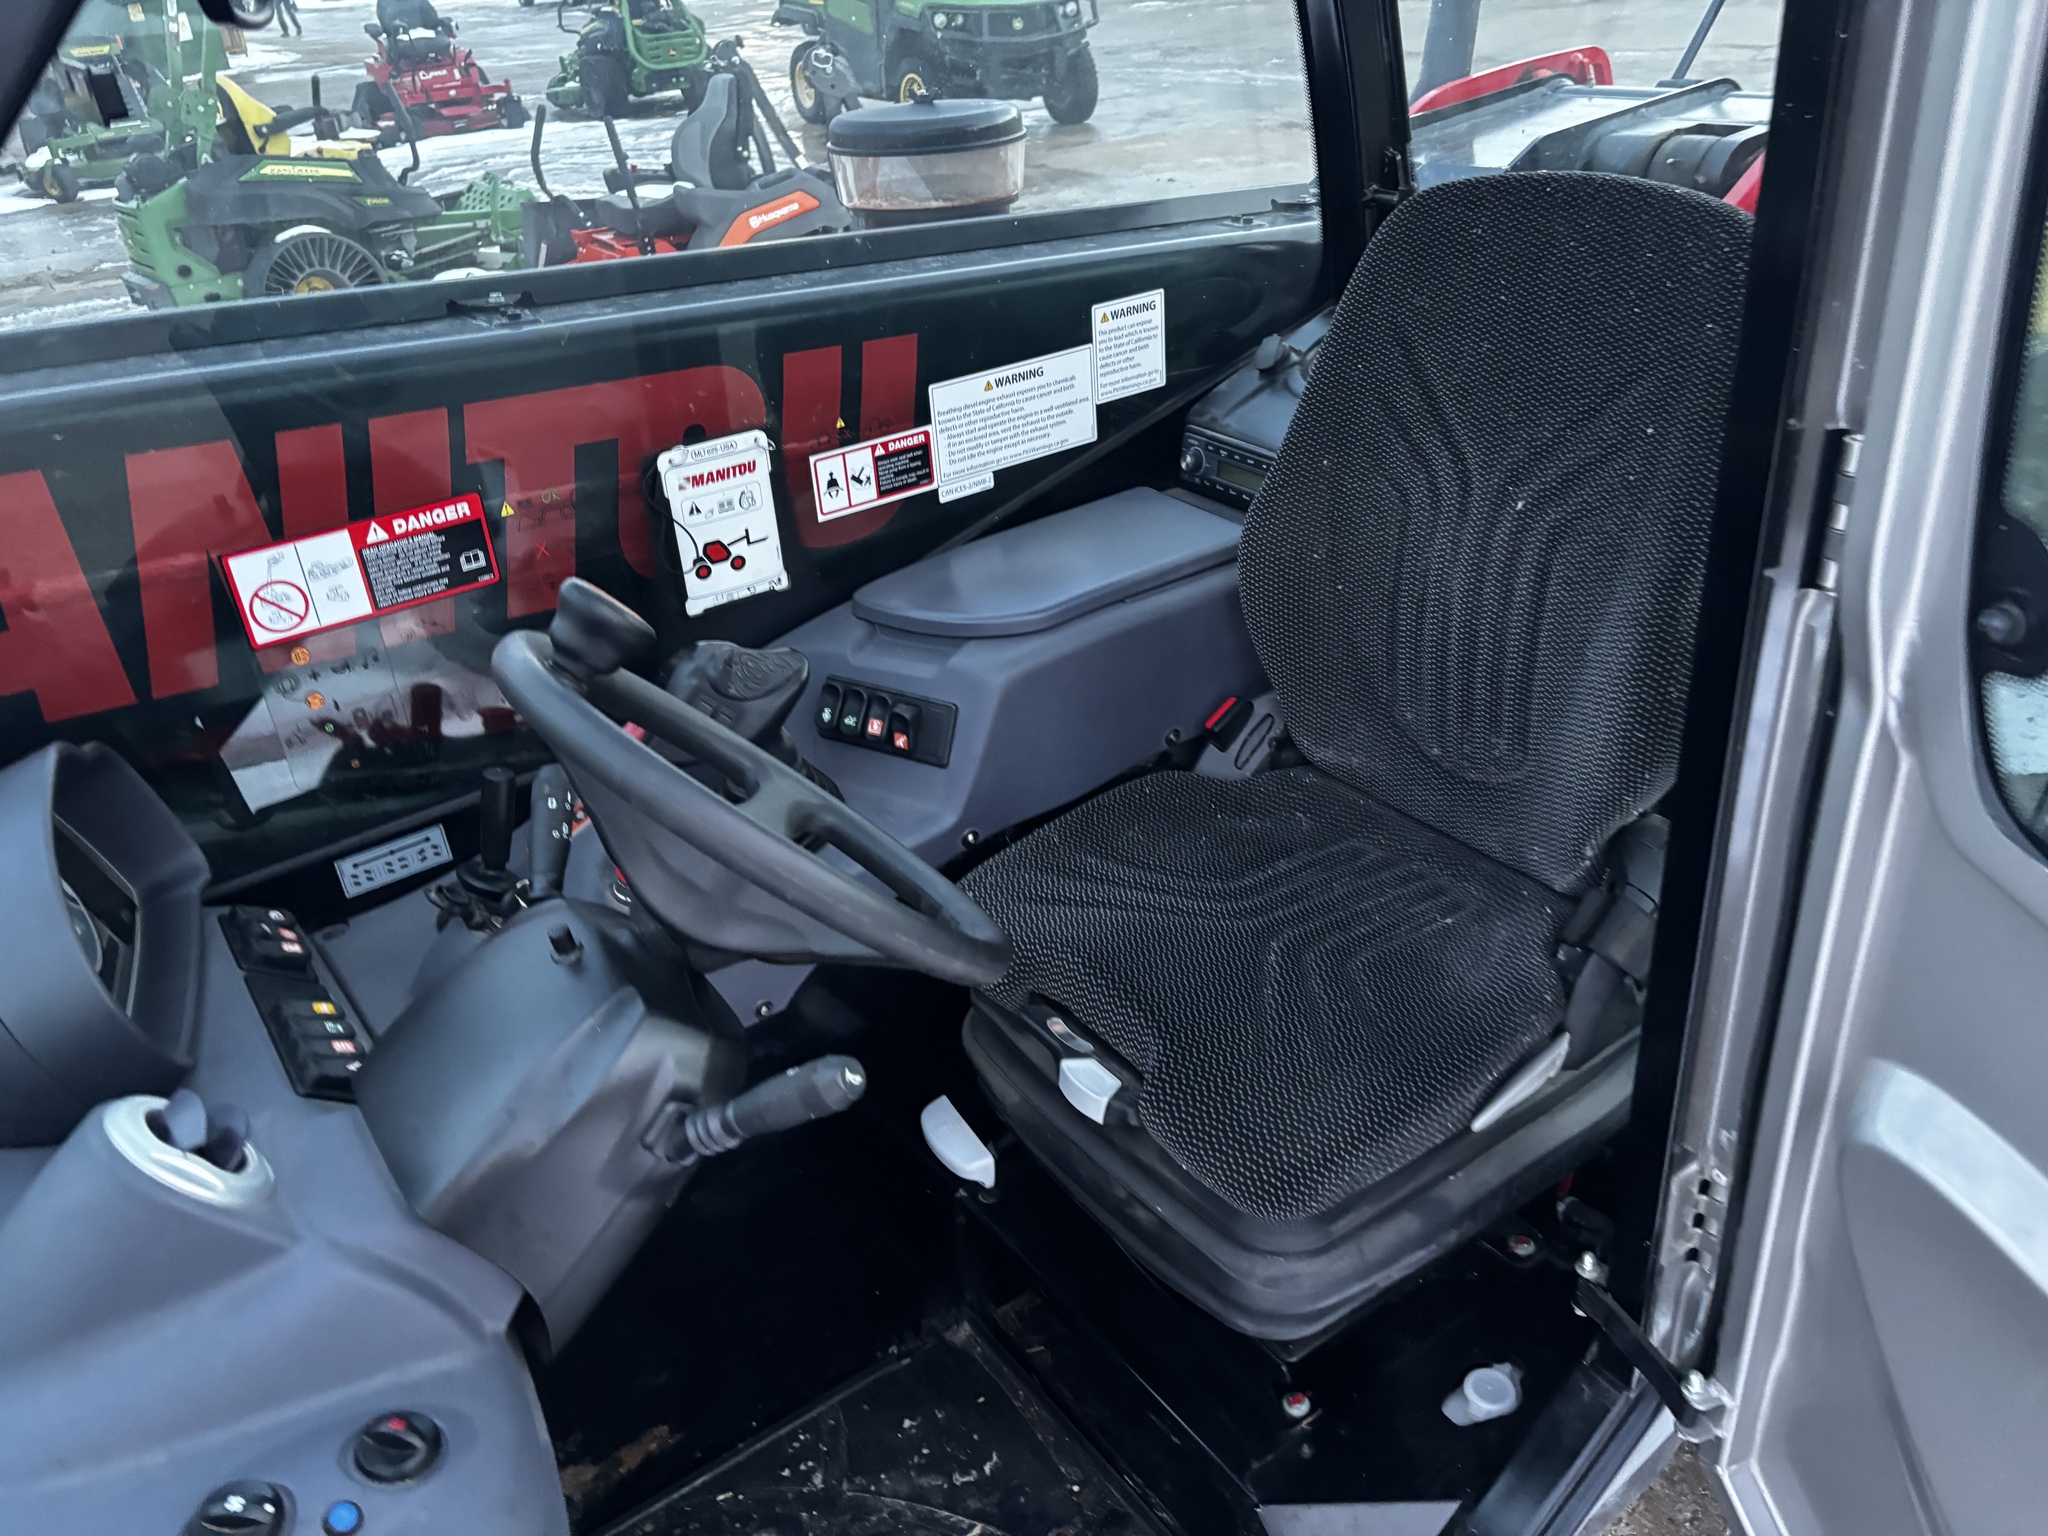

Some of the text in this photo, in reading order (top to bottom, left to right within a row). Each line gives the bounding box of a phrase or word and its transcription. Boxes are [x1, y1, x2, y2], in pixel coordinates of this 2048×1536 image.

[1111, 300, 1156, 321] WARNING
[1108, 324, 1126, 335] product
[1136, 319, 1152, 328] expose
[1099, 354, 1112, 362] cause
[1113, 350, 1127, 358] cancer
[1138, 343, 1149, 351] birth
[1113, 341, 1124, 349] State
[1131, 334, 1152, 345] California
[1099, 360, 1116, 370] defects
[1122, 355, 1135, 363] other
[994, 366, 1044, 389] WARNING
[1121, 371, 1147, 383] information
[937, 405, 962, 419] Breathing
[963, 401, 978, 411] diesel
[978, 396, 996, 408] engine
[996, 391, 1015, 401] exhaust
[1017, 386, 1036, 397] exposes
[1037, 384, 1046, 392] you
[1053, 374, 1075, 386] chemicals
[938, 416, 955, 426] known
[963, 411, 972, 419] the
[972, 408, 985, 416] State
[992, 399, 1015, 411] California
[1022, 395, 1036, 403] cause
[1037, 390, 1052, 399] cancer
[1053, 386, 1062, 394] and
[1063, 383, 1075, 391] birth
[939, 424, 957, 434] defects
[965, 418, 978, 427] other
[979, 409, 1010, 424] reproductive
[1011, 405, 1025, 414] harm.
[947, 430, 964, 442] Always
[965, 427, 977, 435] start
[978, 424, 987, 432] and
[988, 418, 1007, 430] operate
[1017, 411, 1033, 422] engine
[1044, 398, 1078, 413] well-ventilated
[965, 432, 987, 444] enclosed
[988, 430, 1000, 438] area,
[1001, 426, 1011, 434] vent
[1012, 423, 1020, 431] the
[1021, 417, 1040, 428] exhaust
[1047, 413, 1055, 421] the
[1056, 408, 1074, 418] outside.
[888, 434, 926, 452] DANGER
[948, 449, 956, 457] Do
[957, 447, 966, 455] not
[966, 442, 984, 453] modify
[991, 435, 1008, 446] tamper
[1009, 431, 1020, 440] with
[1030, 423, 1048, 434] exhaust
[1049, 418, 1066, 429] system.
[958, 455, 966, 463] not
[967, 452, 976, 460] idle
[977, 449, 986, 457] the
[986, 444, 1003, 456] engine
[1004, 439, 1020, 451] except
[1027, 432, 1051, 444] necessary.
[943, 471, 952, 479] For
[953, 468, 965, 476] more
[967, 458, 995, 472] information
[996, 457, 1002, 465] go
[1010, 437, 1068, 460] www.P65Warnings.ca.gov
[691, 459, 757, 489] MANITOU
[541, 488, 560, 504] OK
[941, 488, 954, 498] CAN
[392, 501, 471, 534] DANGER
